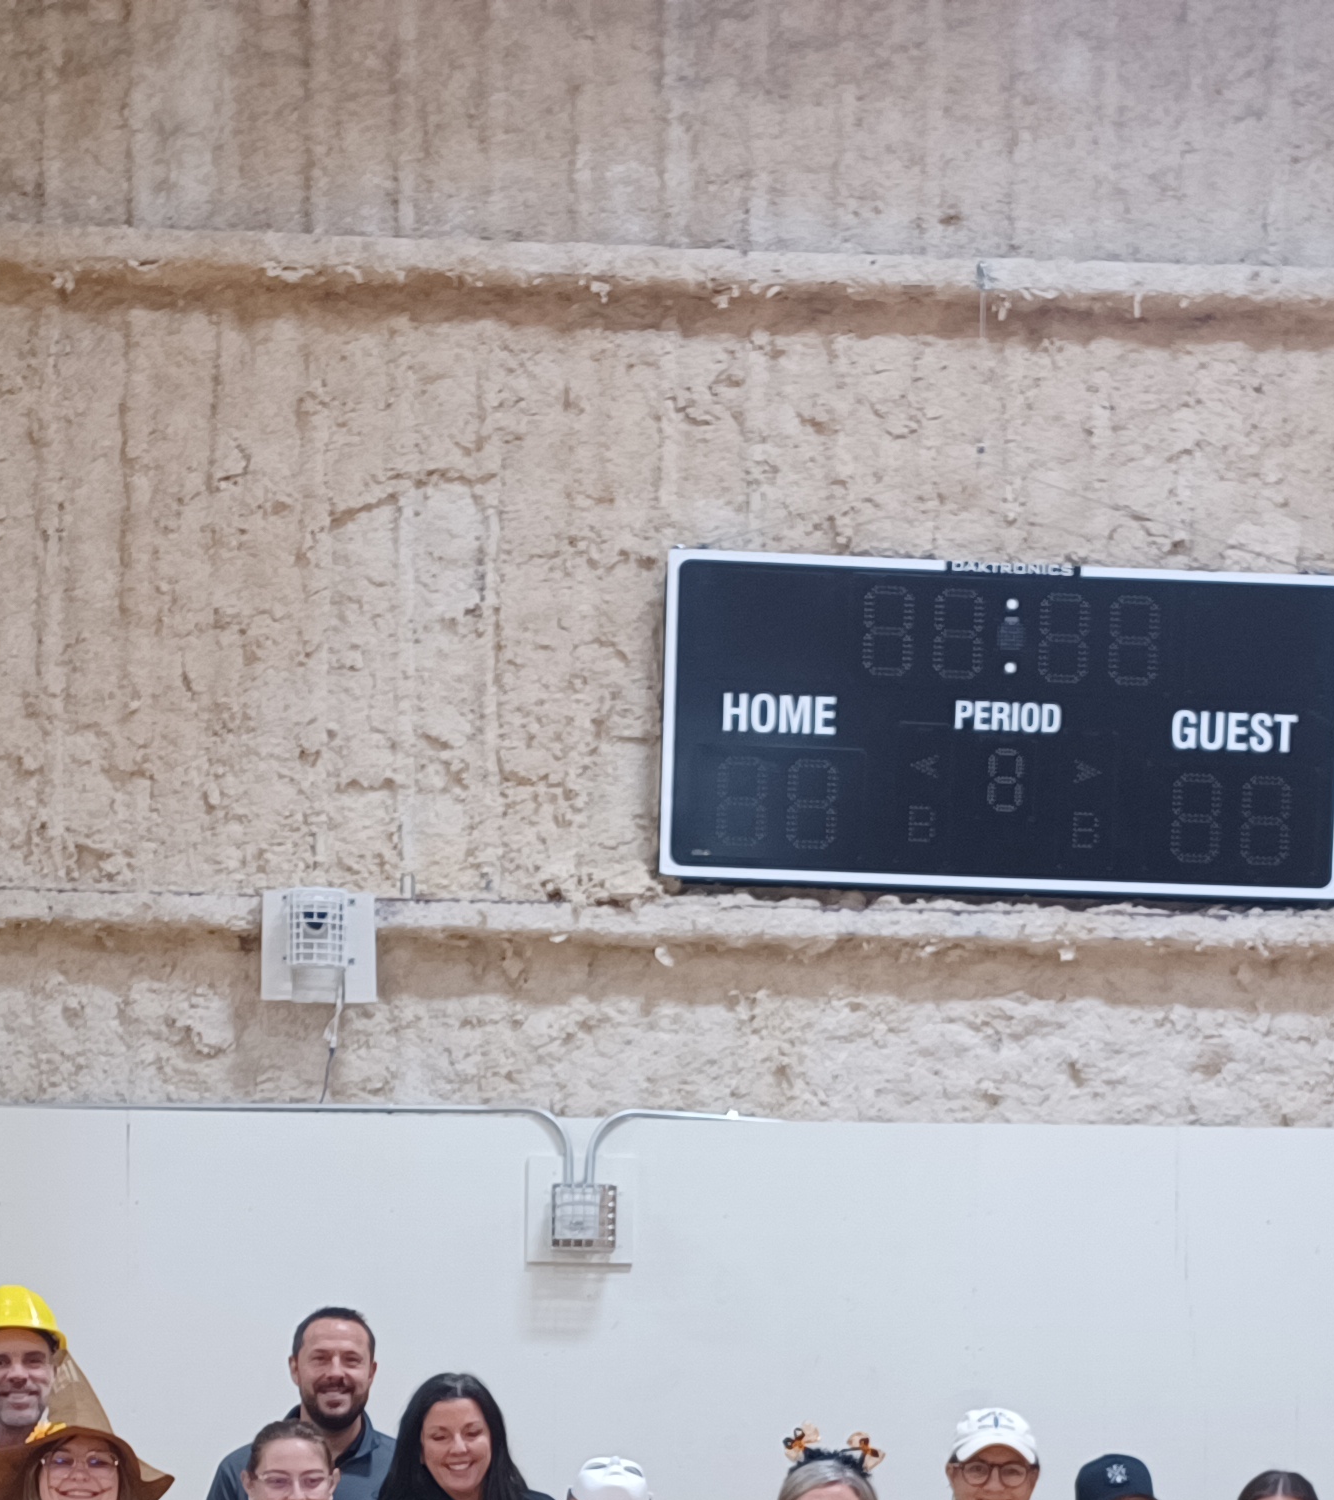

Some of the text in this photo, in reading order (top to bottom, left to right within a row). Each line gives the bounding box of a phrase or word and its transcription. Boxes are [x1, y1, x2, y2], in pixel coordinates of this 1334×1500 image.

[951, 560, 1075, 577] DAKTRONICS
[722, 692, 837, 735] HOME
[954, 699, 1063, 733] PERIOD
[1171, 709, 1300, 753] GUEST
